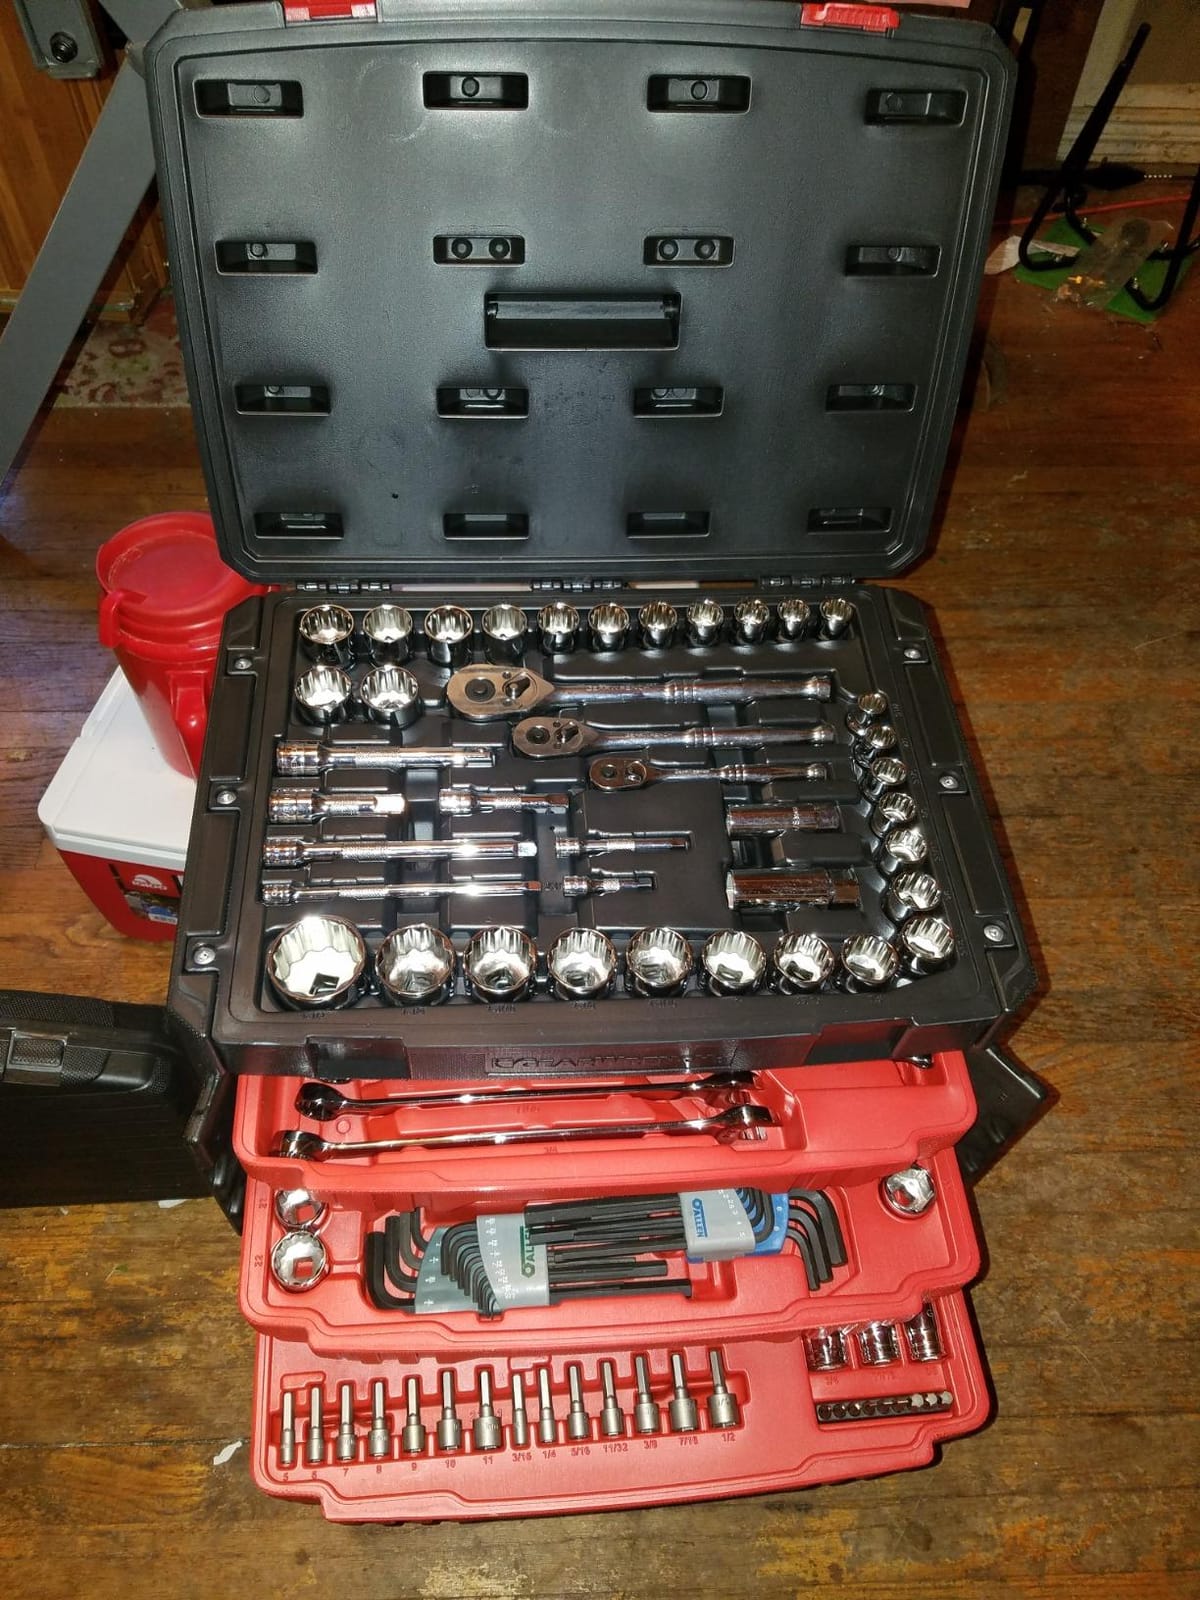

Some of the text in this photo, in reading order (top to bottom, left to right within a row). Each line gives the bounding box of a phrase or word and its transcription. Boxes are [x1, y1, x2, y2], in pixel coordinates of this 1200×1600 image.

[282, 1472, 289, 1481] 5
[311, 1470, 318, 1480] 6
[343, 1467, 350, 1477] 7
[375, 1464, 383, 1474] 8
[411, 1462, 418, 1471] 9
[444, 1459, 457, 1469] 10
[482, 1455, 494, 1465] 11
[602, 1443, 629, 1453] 11/32
[643, 1440, 658, 1449] 3/8
[721, 1432, 736, 1442] 1/2
